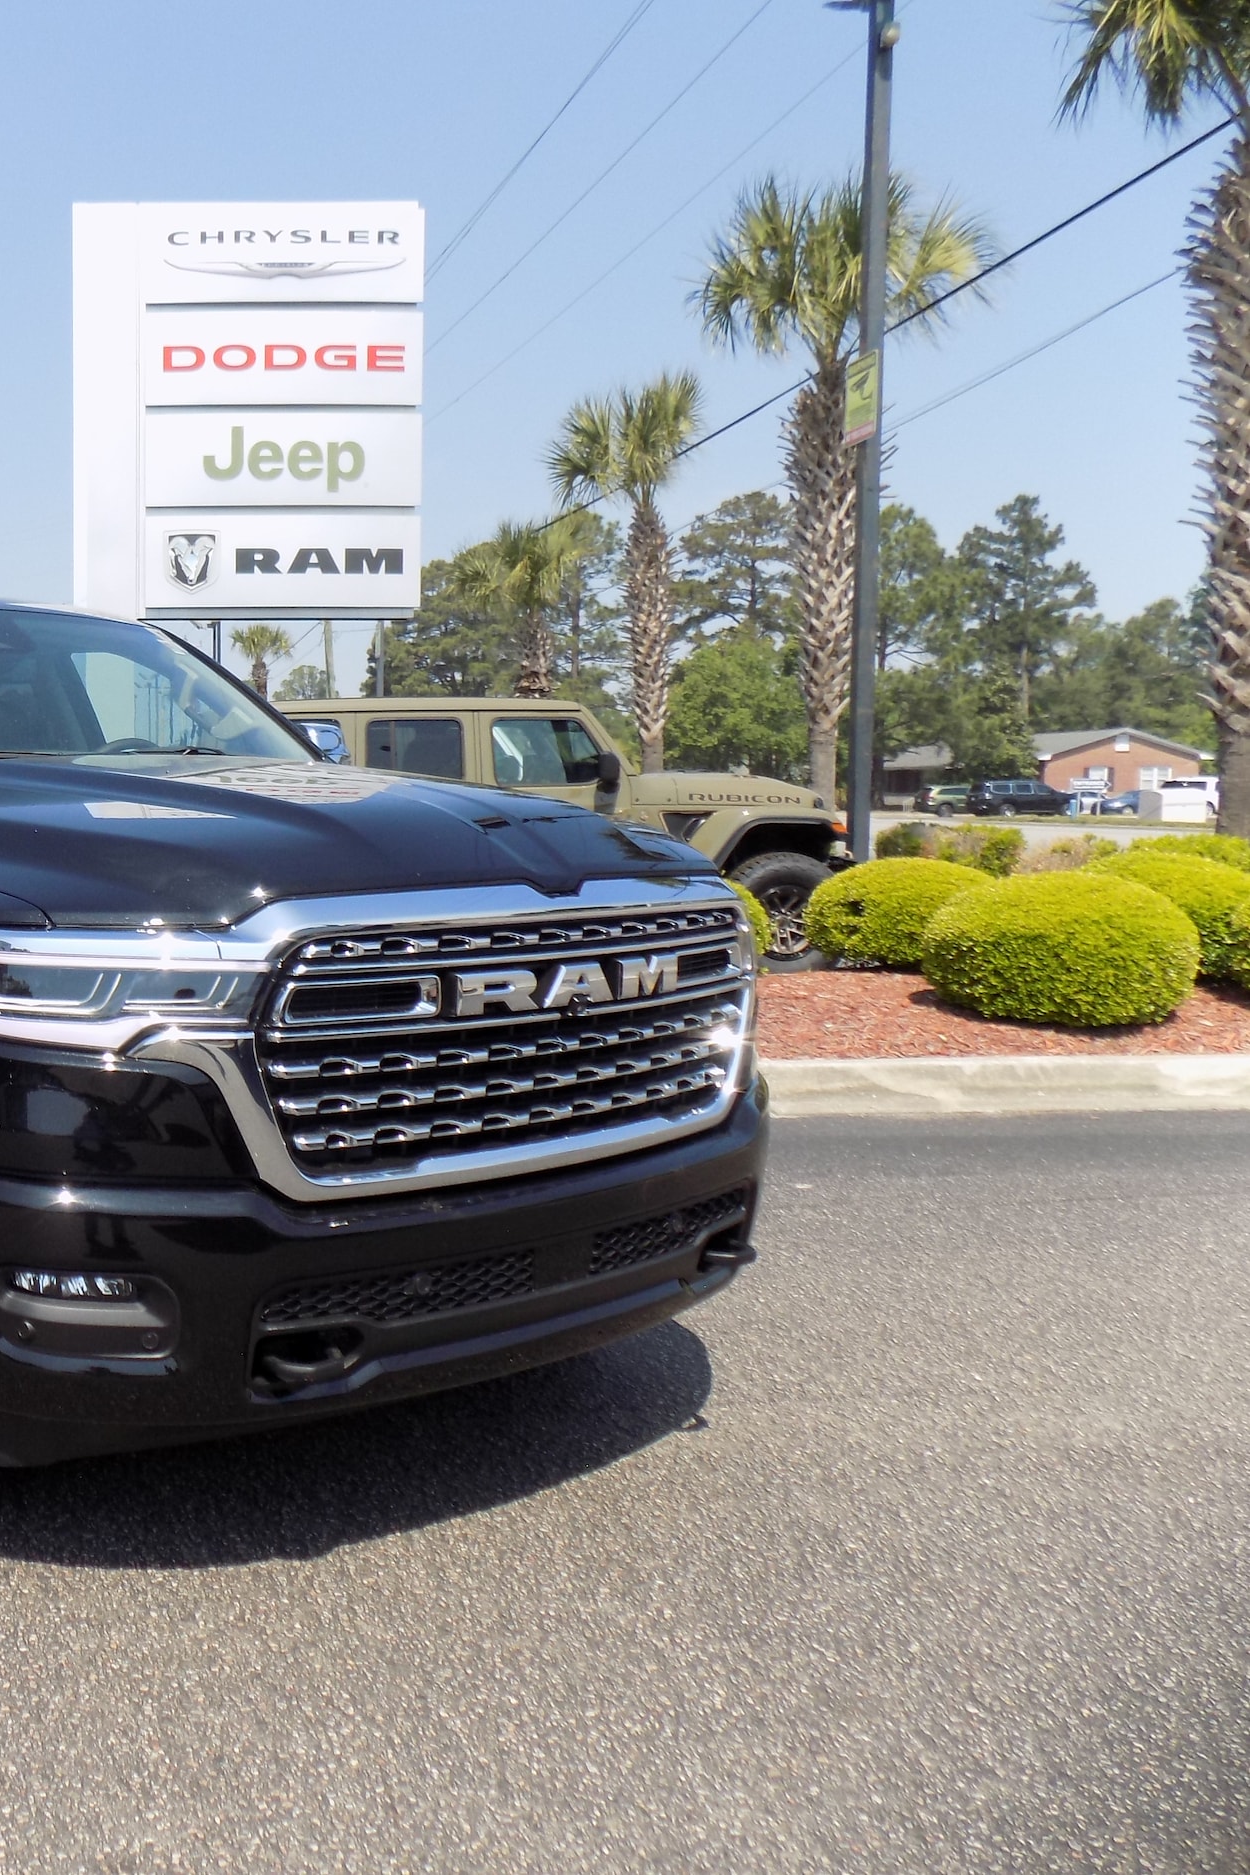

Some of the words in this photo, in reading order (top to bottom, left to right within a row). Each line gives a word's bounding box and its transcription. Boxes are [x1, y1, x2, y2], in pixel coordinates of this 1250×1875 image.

[167, 229, 401, 246] CHRYSLER
[162, 344, 406, 372] DODGE
[202, 425, 366, 492] Jeep
[234, 547, 404, 575] RAM
[688, 792, 802, 805] RUBICON
[452, 952, 678, 1018] RAM
